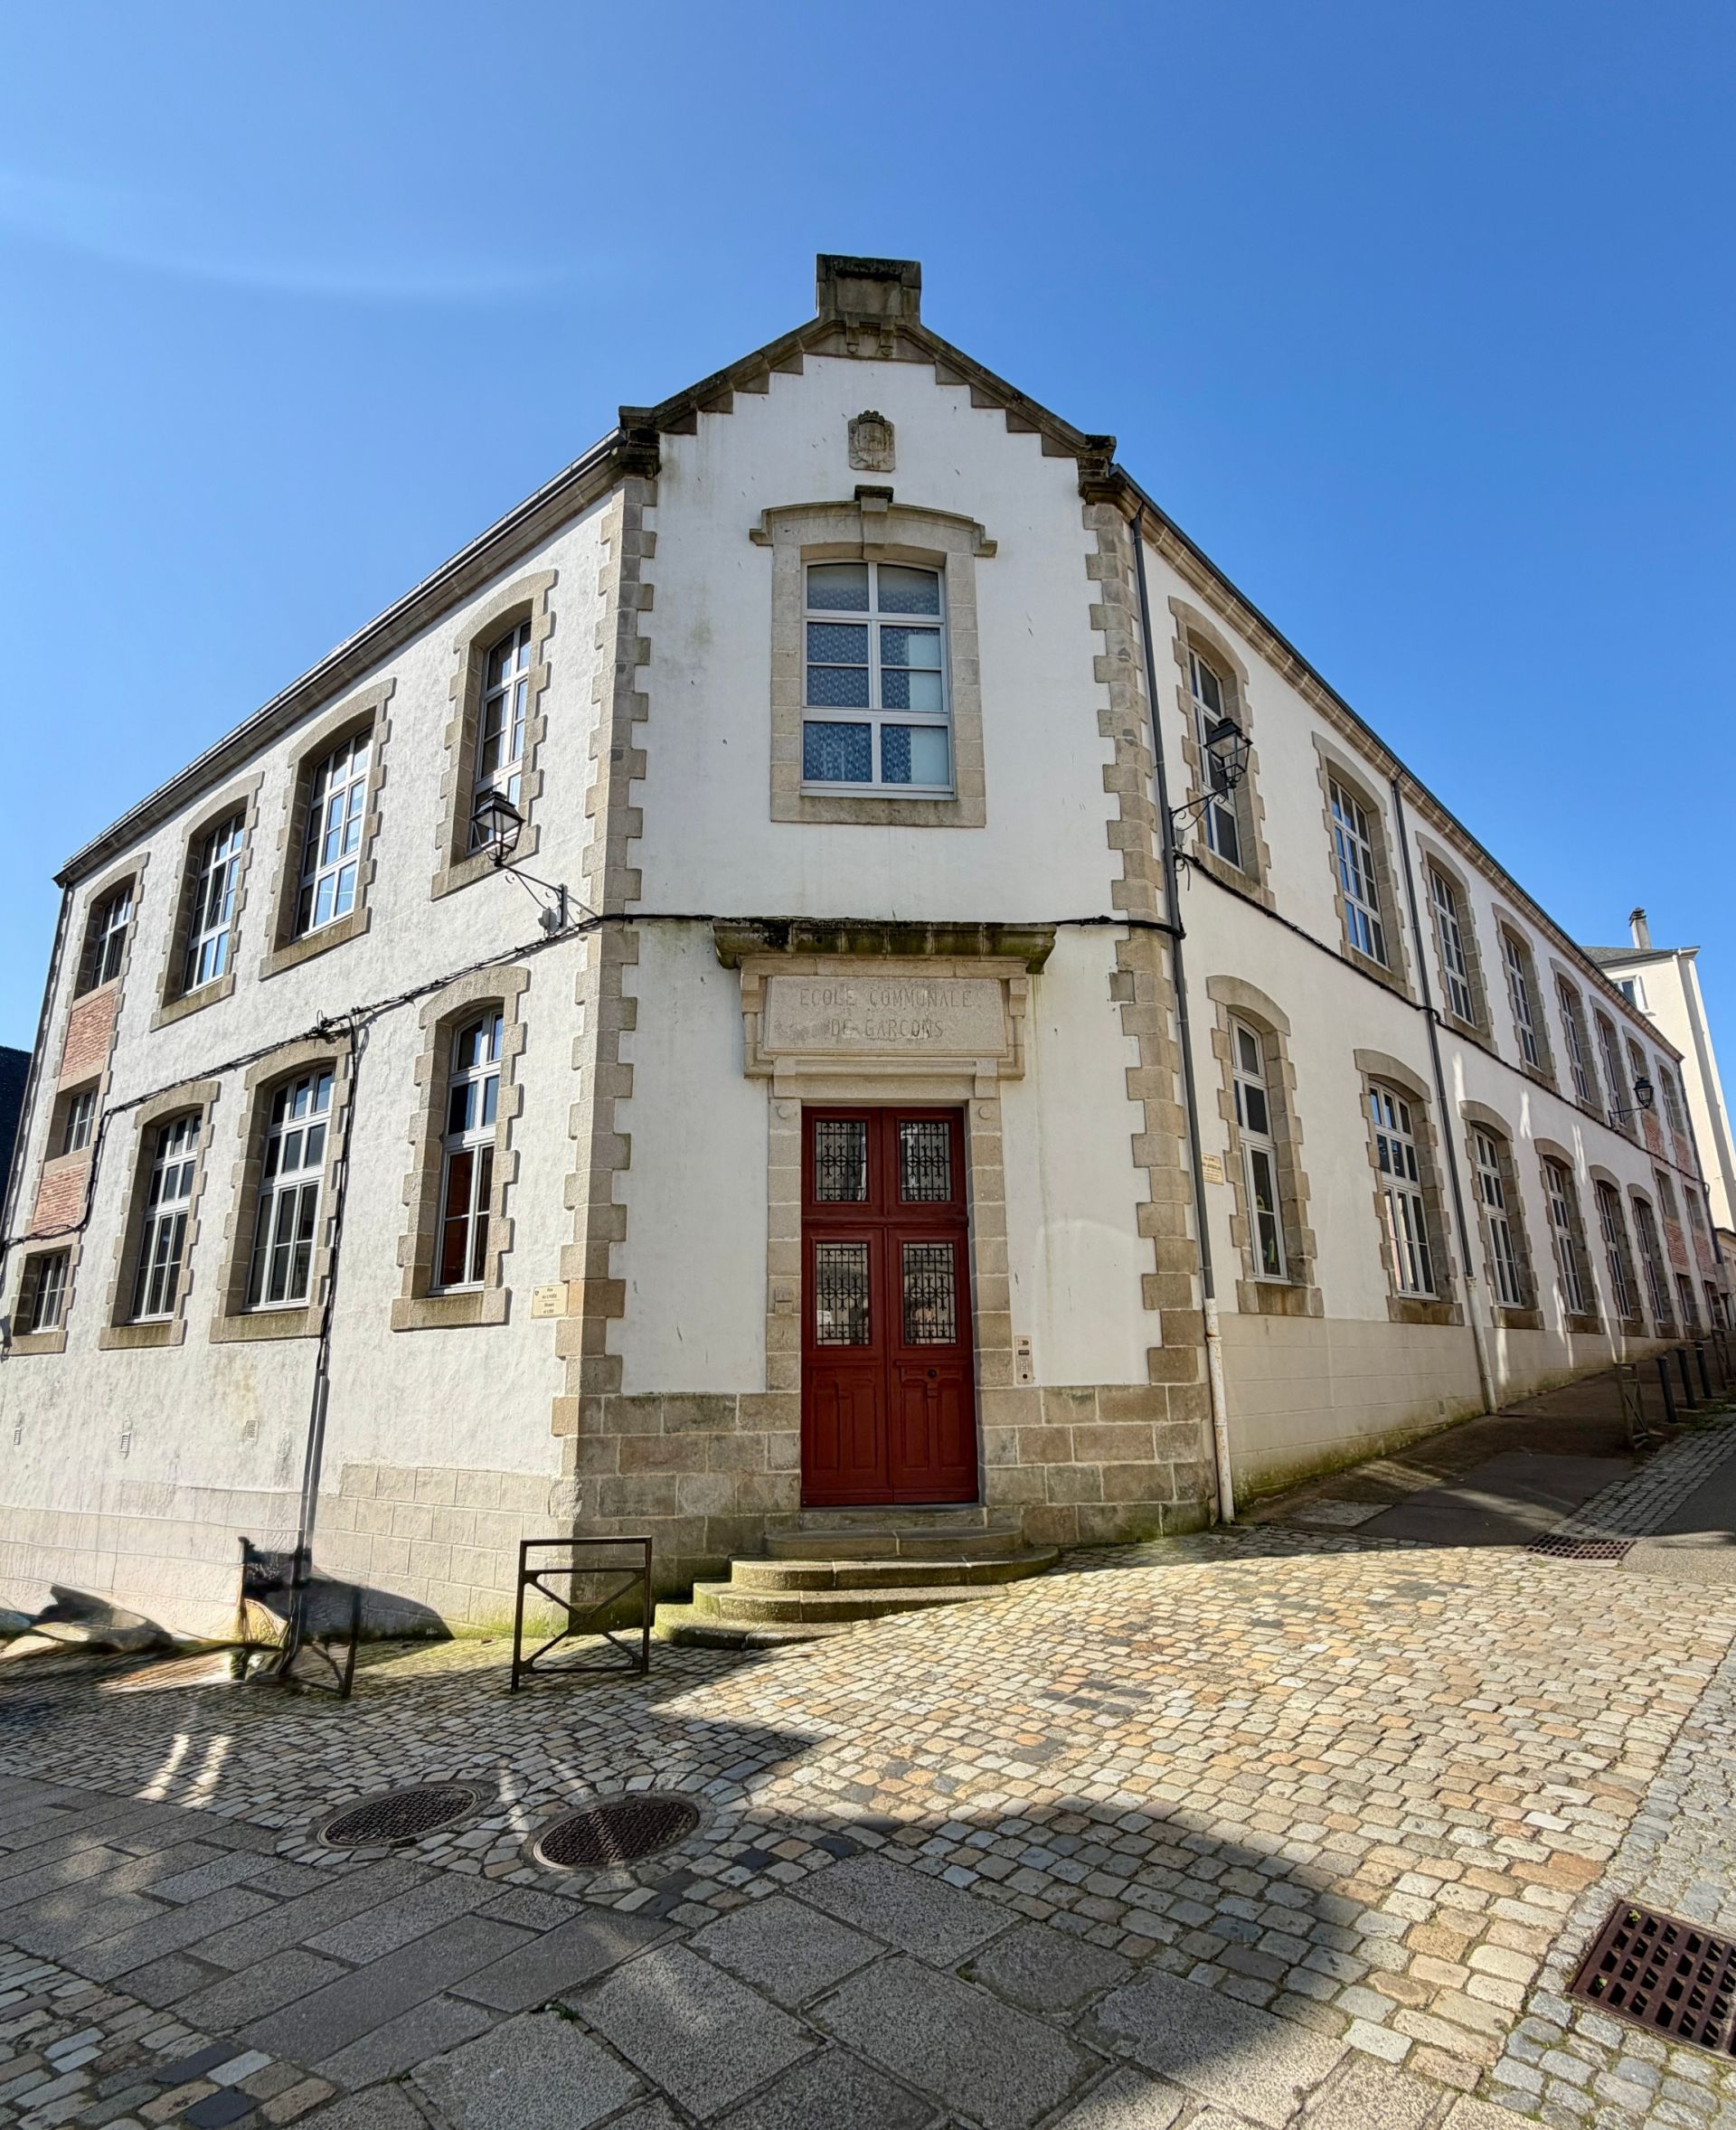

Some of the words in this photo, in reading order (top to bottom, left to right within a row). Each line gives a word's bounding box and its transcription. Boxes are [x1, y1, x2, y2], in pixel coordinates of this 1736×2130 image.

[800, 987, 856, 1007] ECOLE
[870, 988, 973, 1008] COMMUNALE
[831, 1018, 854, 1037] DE
